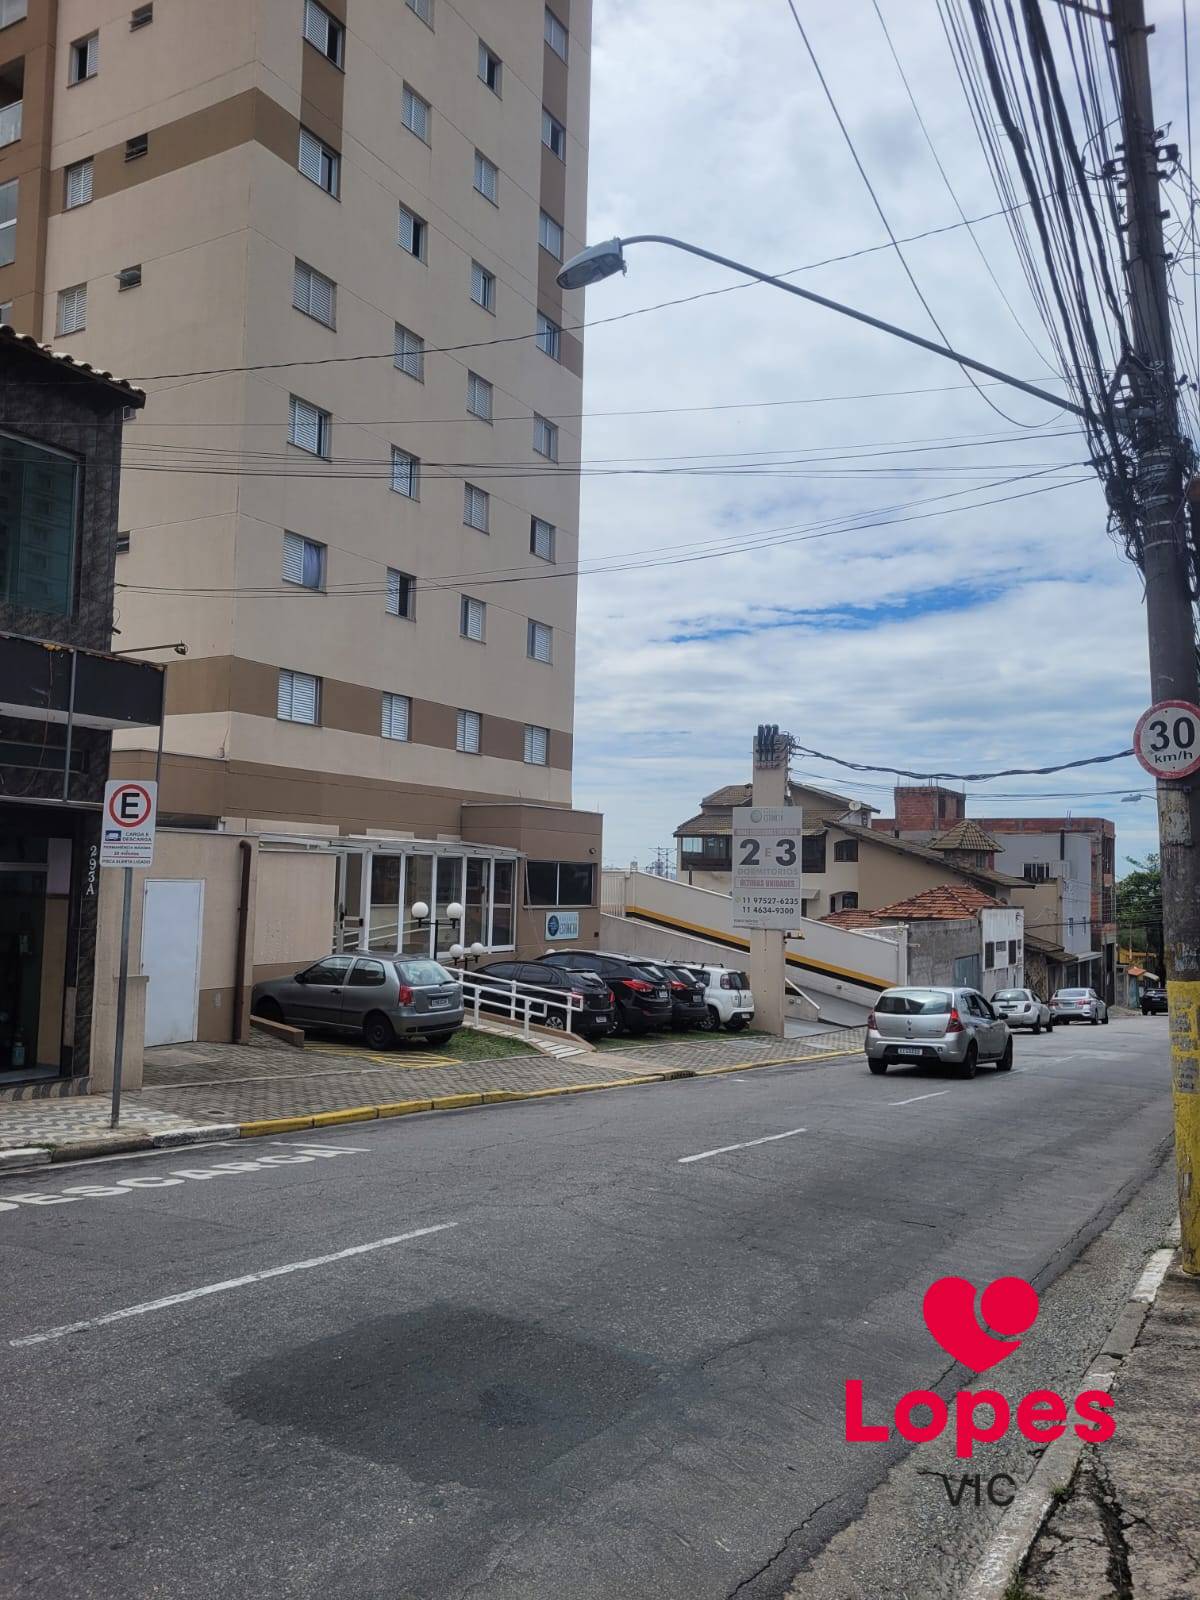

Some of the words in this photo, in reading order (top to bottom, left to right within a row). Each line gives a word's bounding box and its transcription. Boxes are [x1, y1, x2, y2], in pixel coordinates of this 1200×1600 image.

[1149, 716, 1195, 752] 30
[1154, 750, 1193, 763] km/h
[120, 792, 140, 818] E
[739, 839, 760, 866] 2
[765, 848, 772, 857] E
[775, 839, 796, 867] 3
[86, 844, 98, 896] 293A
[765, 879, 795, 888] UNIDADES
[742, 896, 751, 904] 11
[753, 897, 799, 905] 97527-6235
[753, 906, 794, 915] 4634-9300
